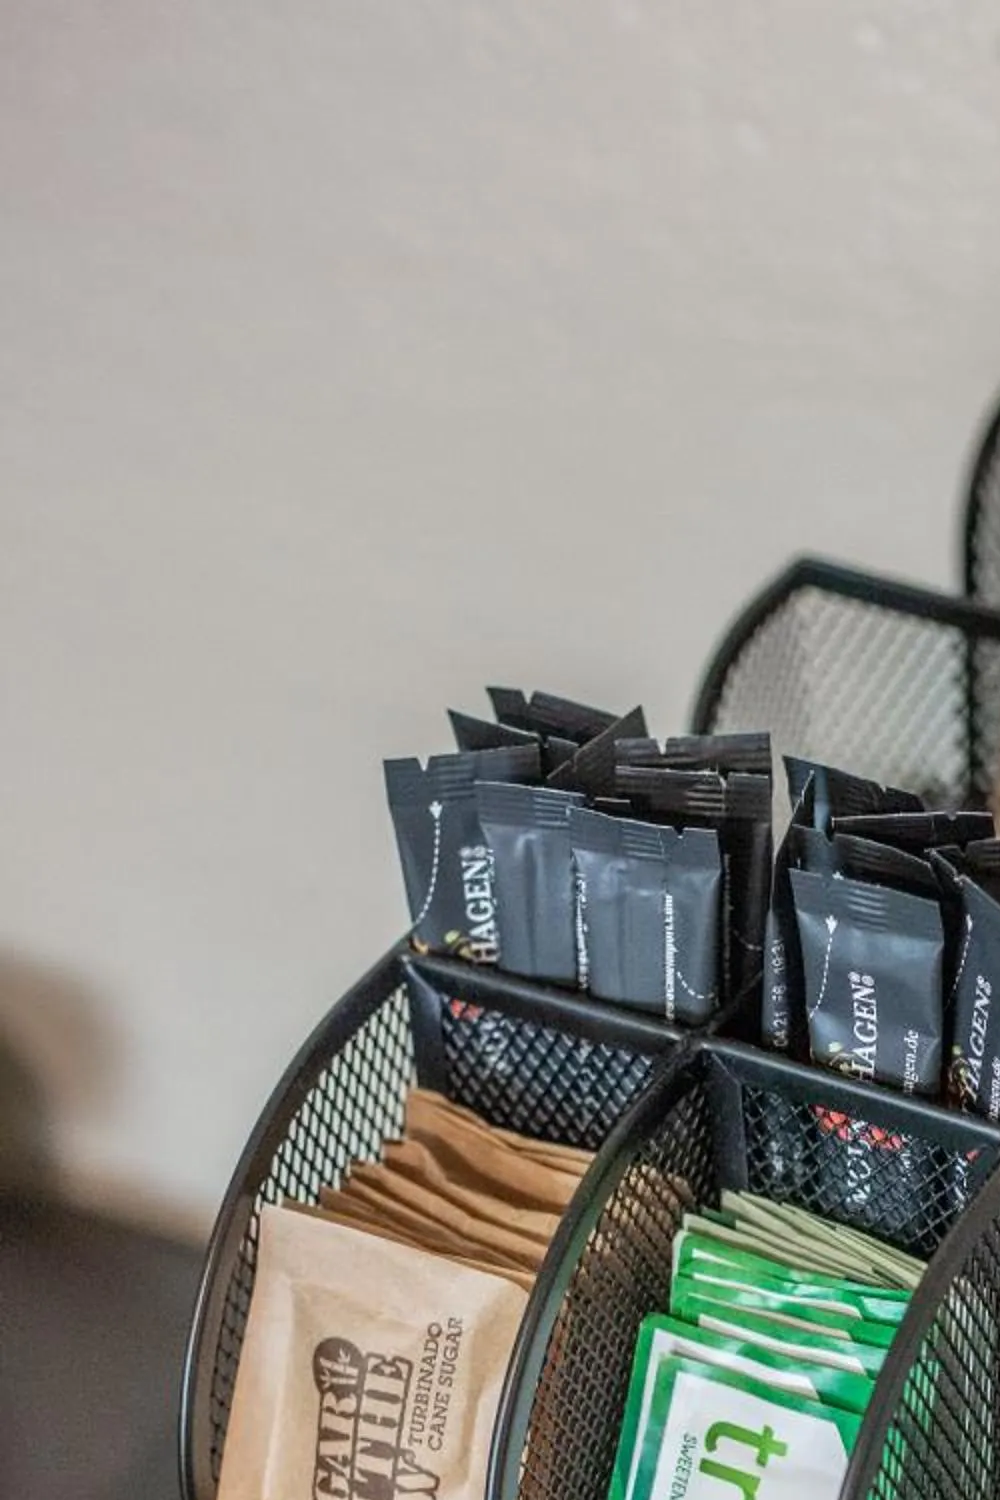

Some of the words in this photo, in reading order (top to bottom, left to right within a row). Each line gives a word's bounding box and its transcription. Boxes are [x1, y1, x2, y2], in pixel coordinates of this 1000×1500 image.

[408, 1322, 443, 1446] TURBINADO
[428, 1384, 450, 1452] CANE
[440, 1317, 463, 1386] SUGAR
